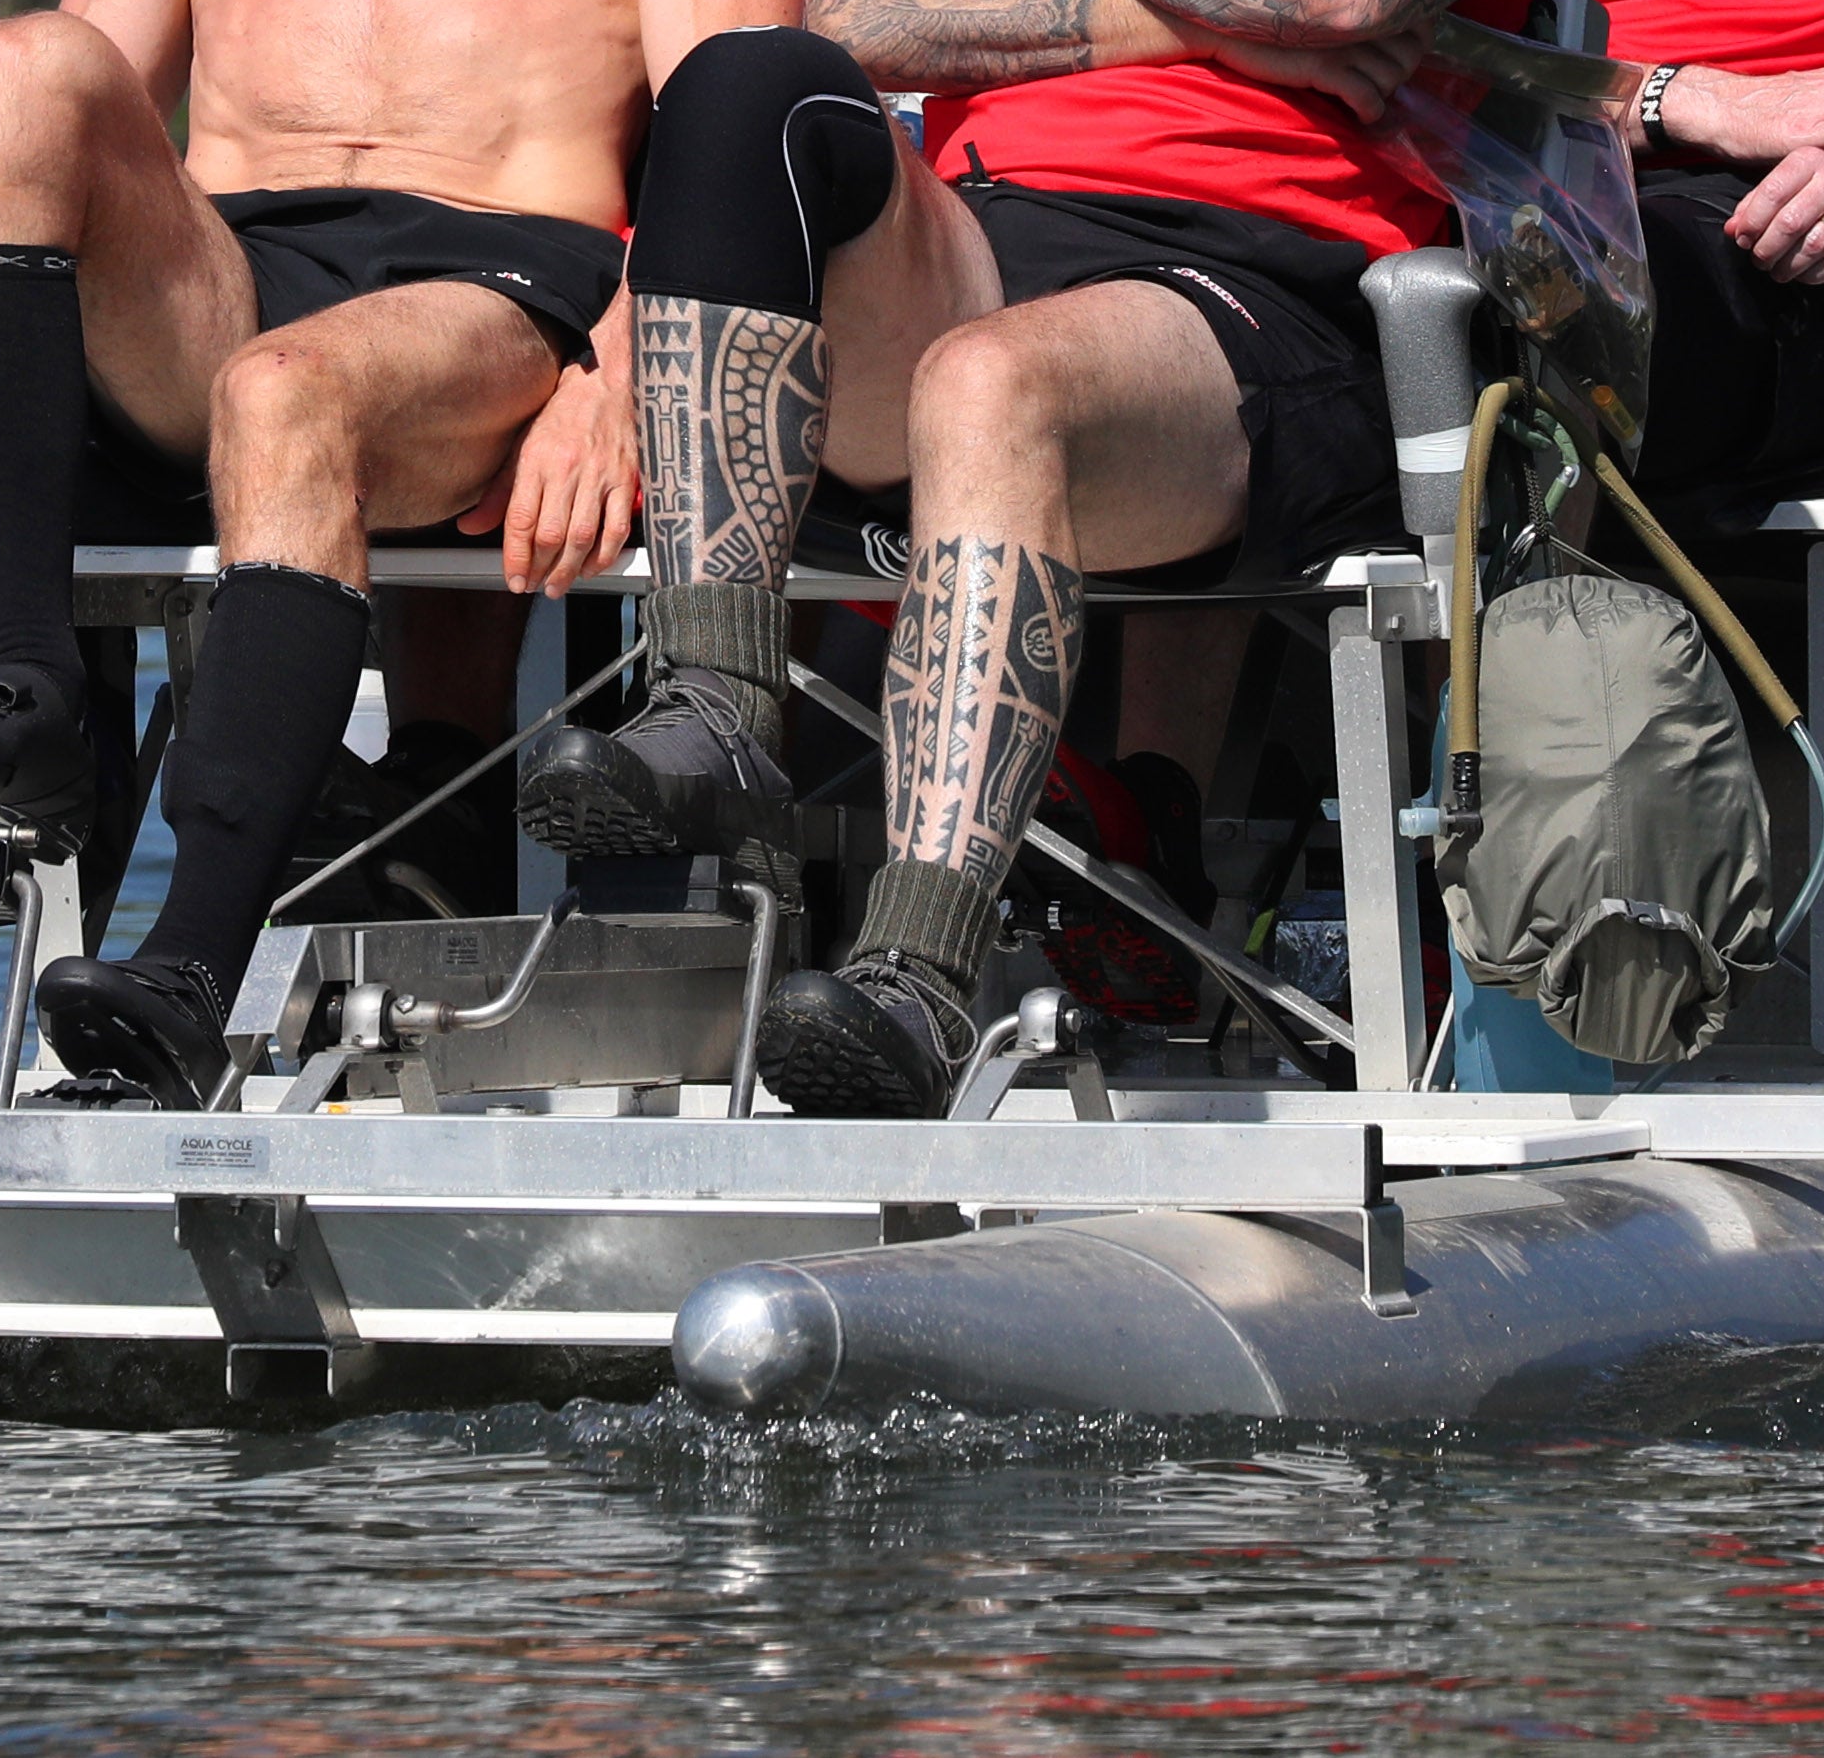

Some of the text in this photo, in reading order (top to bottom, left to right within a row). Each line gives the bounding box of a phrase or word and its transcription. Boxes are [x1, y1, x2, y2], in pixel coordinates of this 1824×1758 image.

[1641, 67, 1676, 122] RUN
[180, 1138, 253, 1151] AQUA CYCLE
